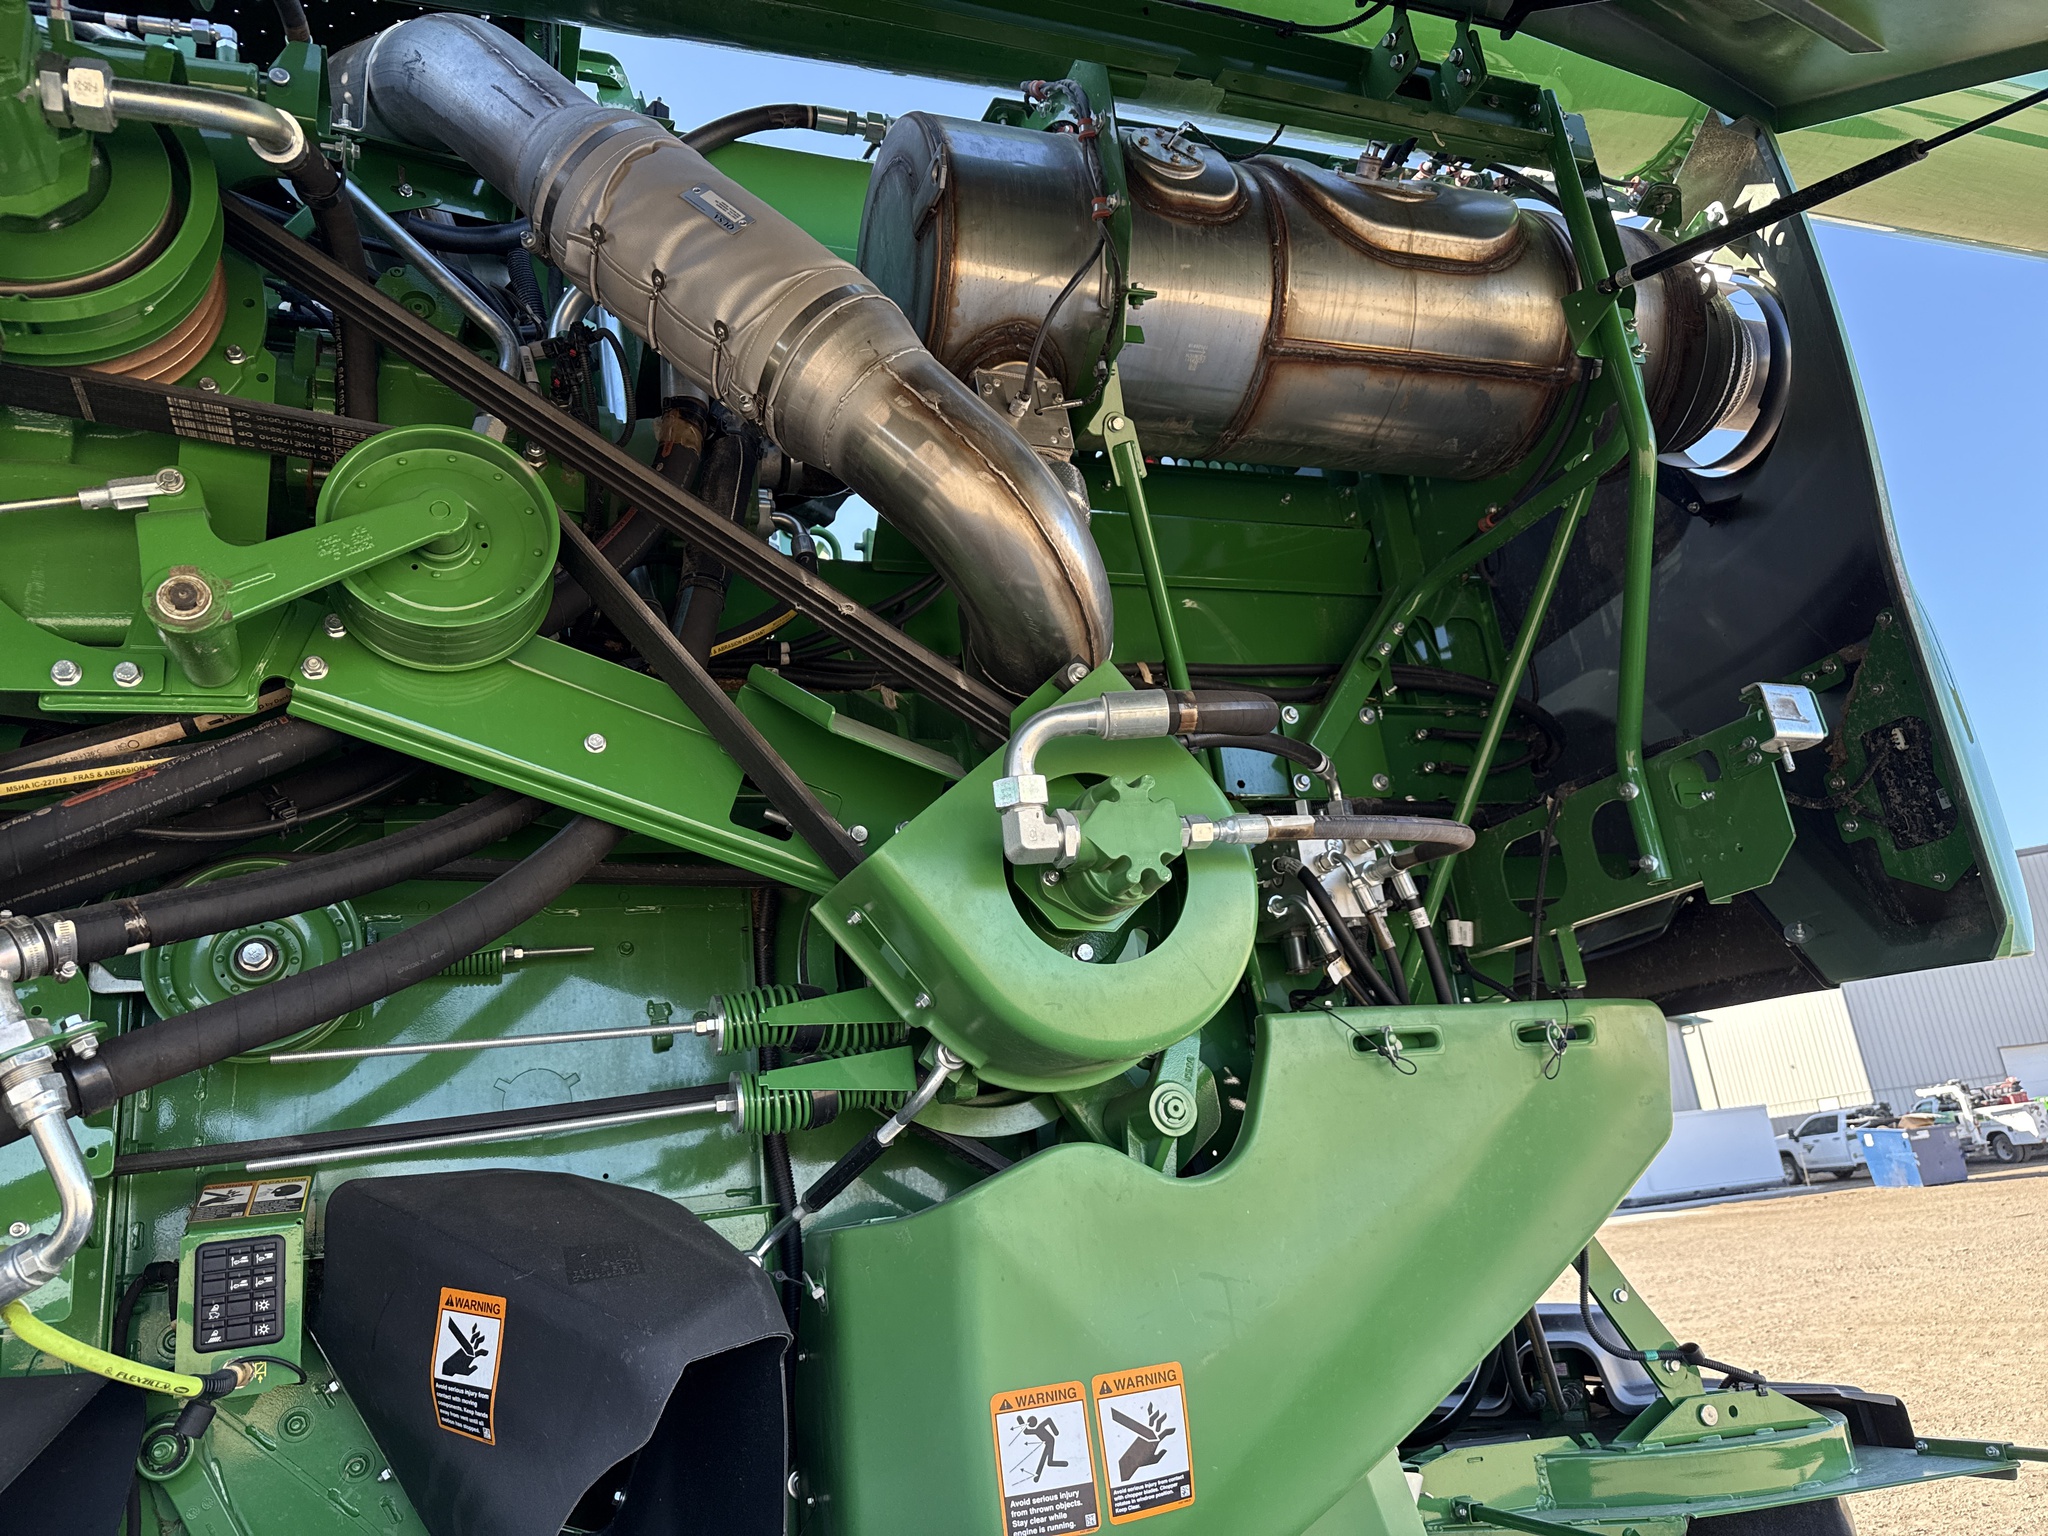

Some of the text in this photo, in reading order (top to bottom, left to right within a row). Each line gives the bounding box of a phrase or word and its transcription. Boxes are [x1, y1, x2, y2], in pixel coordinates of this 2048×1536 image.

[191, 744, 216, 759] MSHA
[5, 781, 30, 792] MSHA
[30, 774, 68, 788] IC-227/12
[72, 770, 95, 781] FRAS
[95, 769, 103, 777] &
[103, 762, 145, 777] ABRASION
[455, 1296, 500, 1315] WARNING
[1113, 1369, 1177, 1391] WARNING
[435, 1382, 489, 1400] Avoid serious injury from
[436, 1392, 478, 1408] contact with moving
[1015, 1387, 1077, 1408] WARNING
[463, 1407, 474, 1416] Keep
[475, 1409, 488, 1419] hands
[1113, 1488, 1127, 1496] Avoid
[1127, 1484, 1144, 1493] serious
[1144, 1481, 1157, 1490] injury
[1168, 1474, 1185, 1483] contact
[1125, 1491, 1143, 1500] chopper
[1160, 1482, 1178, 1492] Chopper
[1010, 1490, 1080, 1509] Avoid serious injury
[1114, 1499, 1131, 1507] rotates
[1136, 1493, 1155, 1502] windrow
[1155, 1489, 1174, 1499] position.
[1010, 1500, 1084, 1518] from thrown objects.
[1115, 1505, 1127, 1514] Keep
[1011, 1511, 1068, 1529] Stay clear while
[1013, 1526, 1038, 1536] engine
[1038, 1523, 1046, 1533] is
[1047, 1520, 1076, 1532] running.
